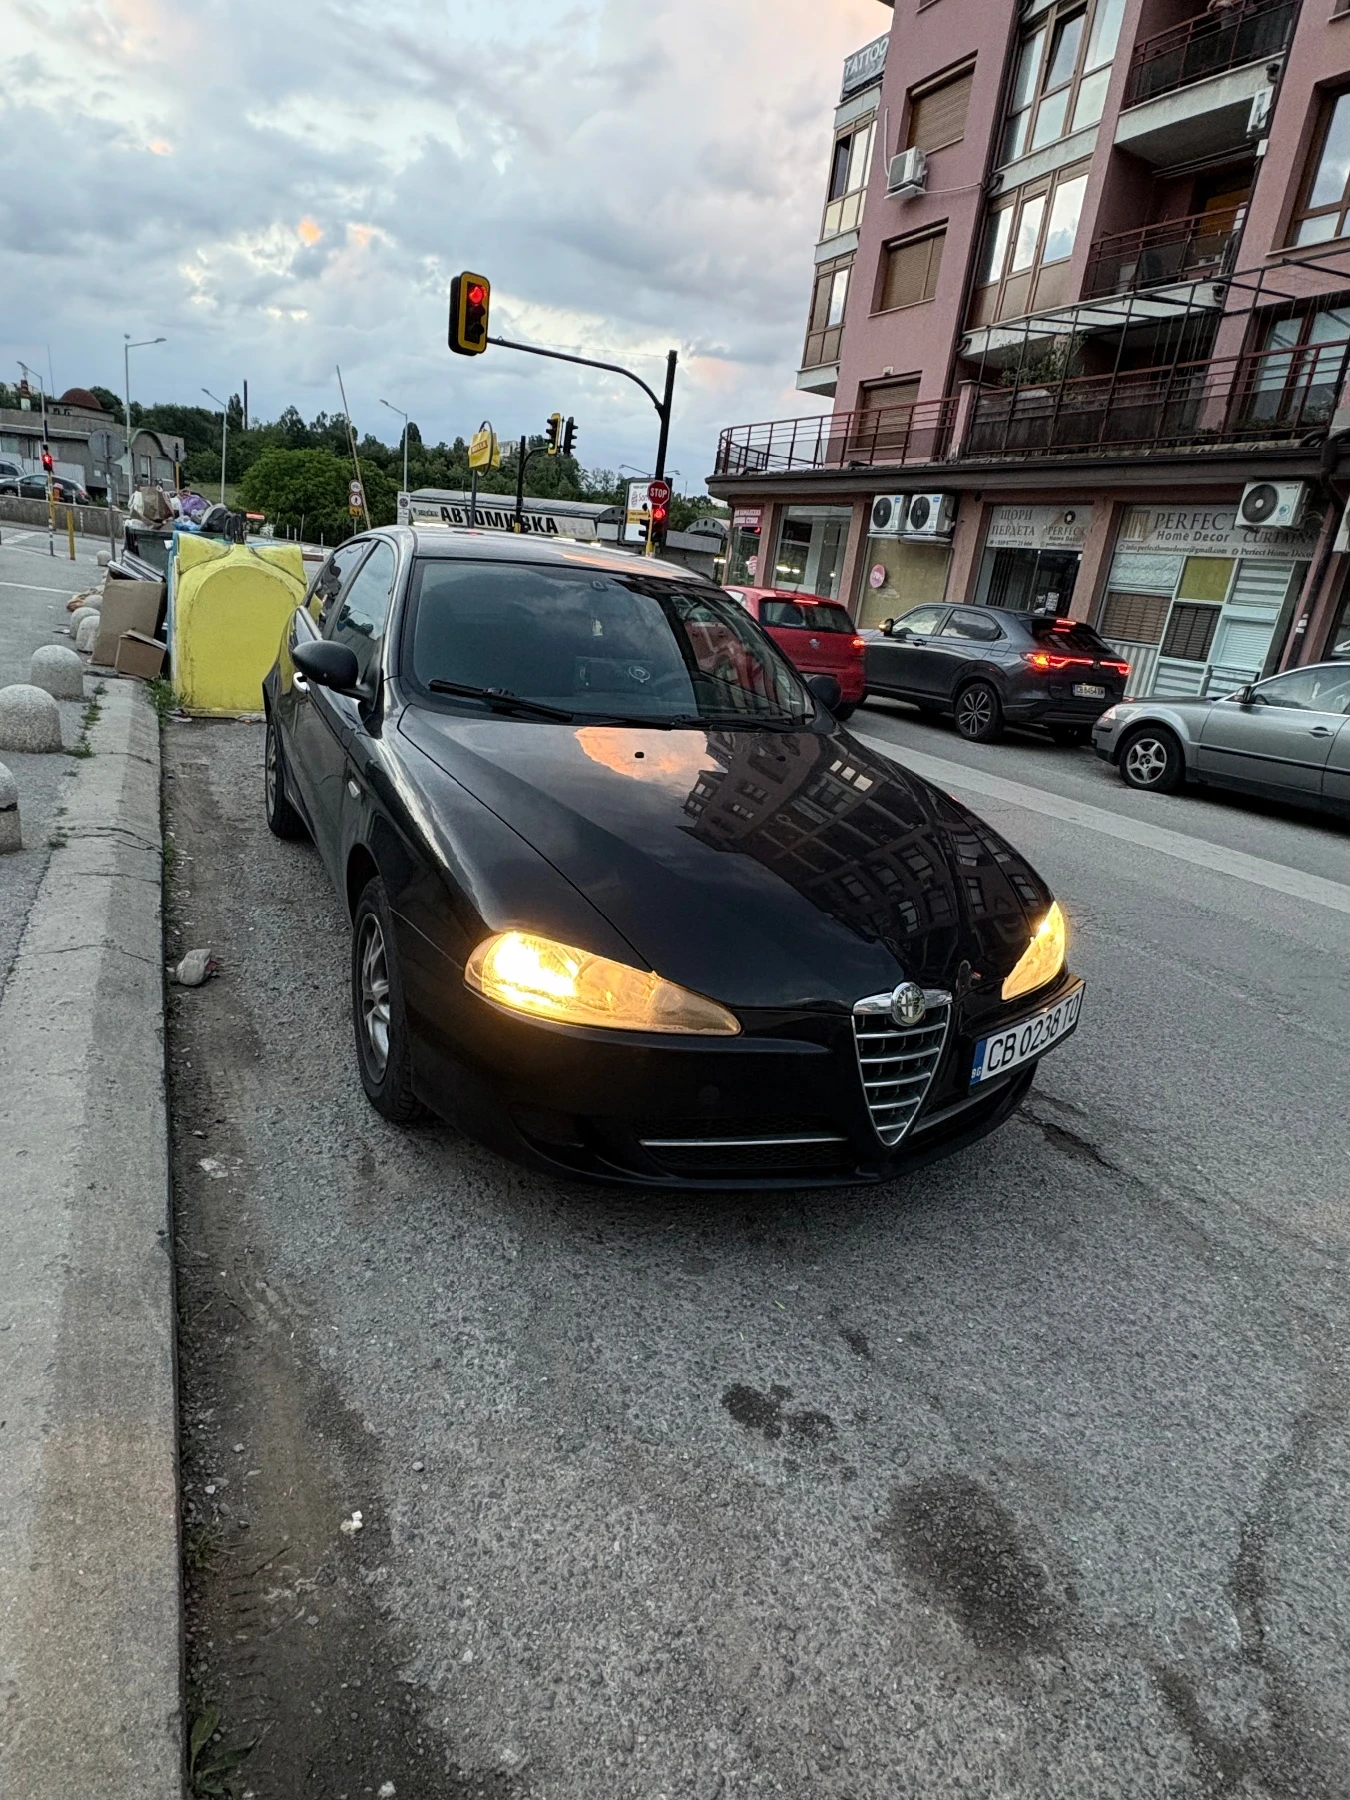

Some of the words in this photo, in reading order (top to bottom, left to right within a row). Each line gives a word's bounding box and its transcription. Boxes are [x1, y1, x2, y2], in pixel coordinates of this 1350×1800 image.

[845, 37, 889, 76] TATTOO
[649, 487, 668, 498] STOP
[1000, 509, 1033, 521] ЩОРИ
[1154, 512, 1238, 531] PERFECT
[991, 524, 1035, 536] ПЕРДЕТА
[1156, 530, 1189, 541] Home
[1193, 530, 1230, 543] Decor
[1241, 547, 1266, 556] Perfect
[1266, 548, 1290, 557] Home
[988, 1033, 1017, 1072] CB
[1019, 1008, 1062, 1058] 0238
[1061, 993, 1080, 1030] TO
[971, 1066, 982, 1079] BG
